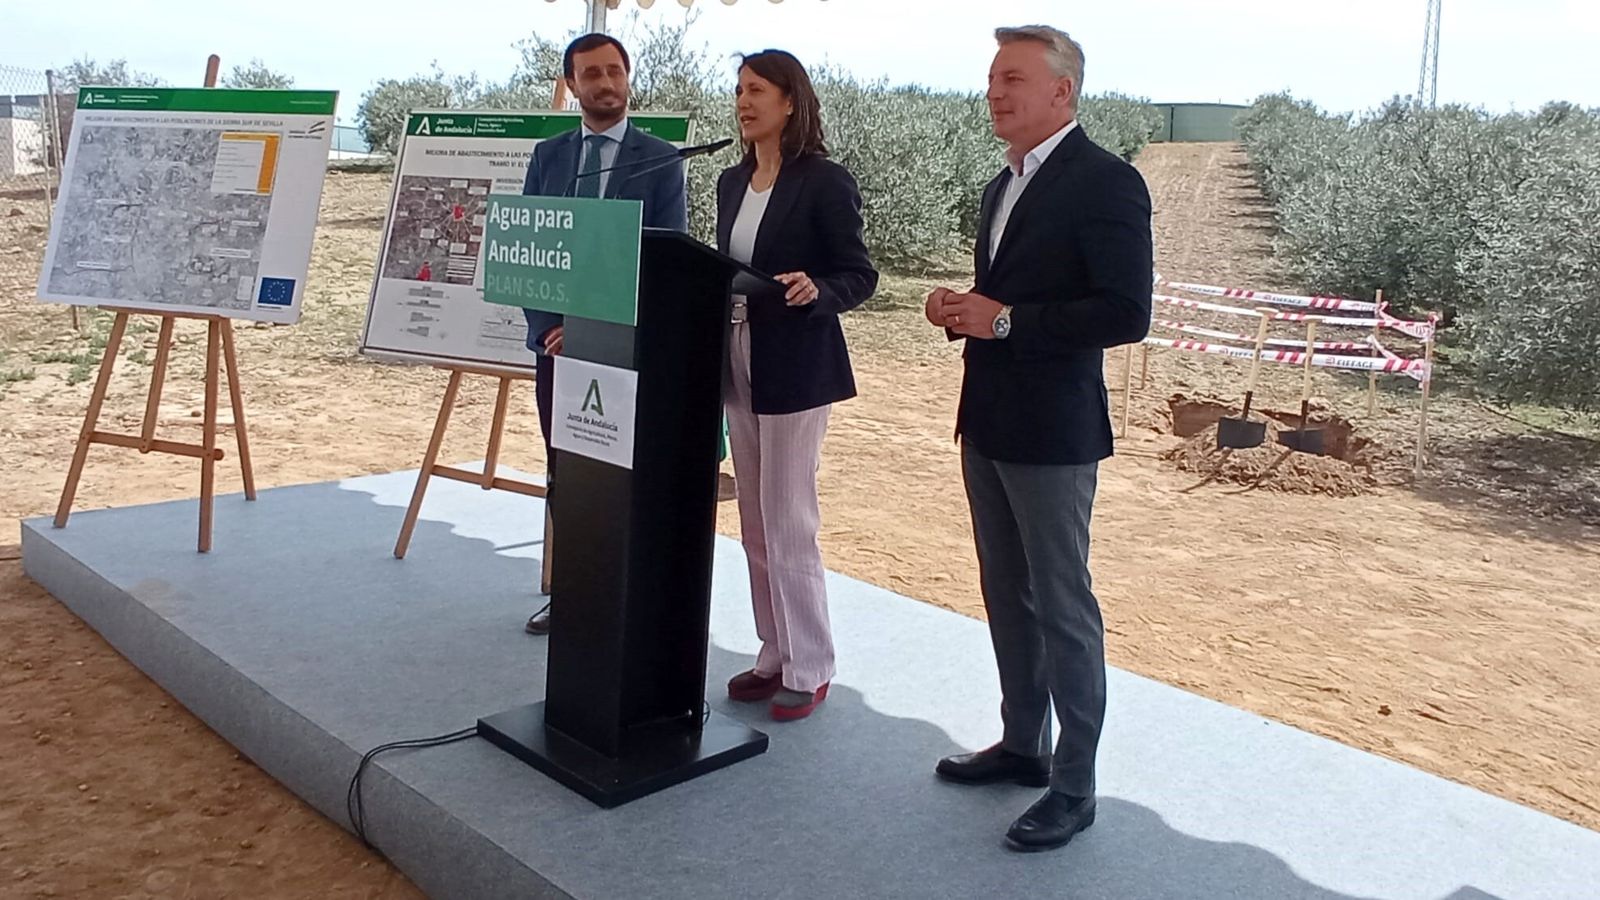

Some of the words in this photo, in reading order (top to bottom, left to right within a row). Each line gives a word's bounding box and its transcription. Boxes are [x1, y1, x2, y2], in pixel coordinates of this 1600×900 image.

[489, 201, 530, 231] Agua
[534, 208, 574, 233] para
[488, 239, 572, 270] Andalucía
[486, 274, 522, 296] PLAN
[526, 279, 569, 303] S.O.S.
[567, 412, 582, 424] Junta
[590, 418, 618, 432] Andalucía
